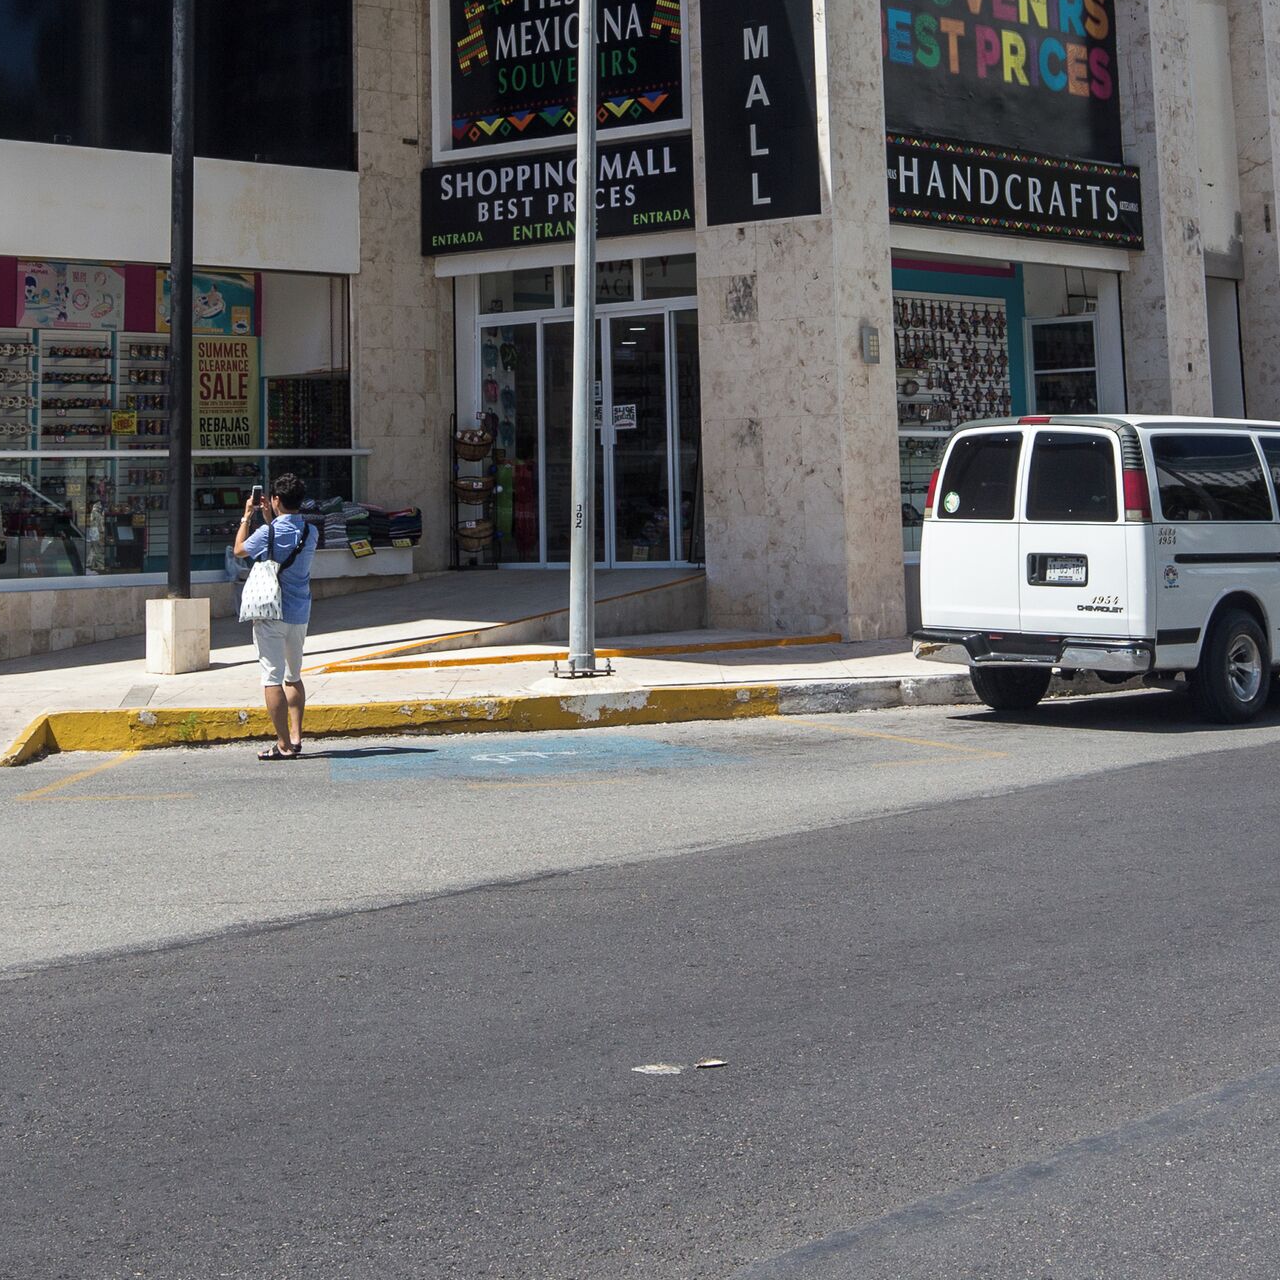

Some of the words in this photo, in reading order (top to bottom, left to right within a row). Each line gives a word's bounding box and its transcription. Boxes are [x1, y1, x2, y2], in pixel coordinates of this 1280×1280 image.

[495, 2, 644, 61] MEXICNA
[880, 6, 965, 74] EST
[975, 23, 1113, 100] PRICES
[498, 46, 638, 95] SOUVEIRS
[743, 24, 772, 206] MALL
[599, 146, 677, 182] MALL
[898, 155, 1119, 222] HANDCRAFTS
[477, 196, 534, 223] BEST
[547, 184, 637, 216] PRCES
[513, 217, 598, 242] ENTRAN
[632, 208, 691, 226] ENTRADA
[431, 231, 484, 247] ENTRADA
[198, 342, 249, 358] SUMMER
[198, 359, 249, 372] CLEARANCE
[199, 372, 249, 401] SALE
[199, 417, 249, 432] REBAJAS
[200, 434, 211, 447] DE
[213, 433, 250, 446] VERANO
[1076, 605, 1124, 614] CHEVROLET
[1091, 596, 1120, 605] 1954
